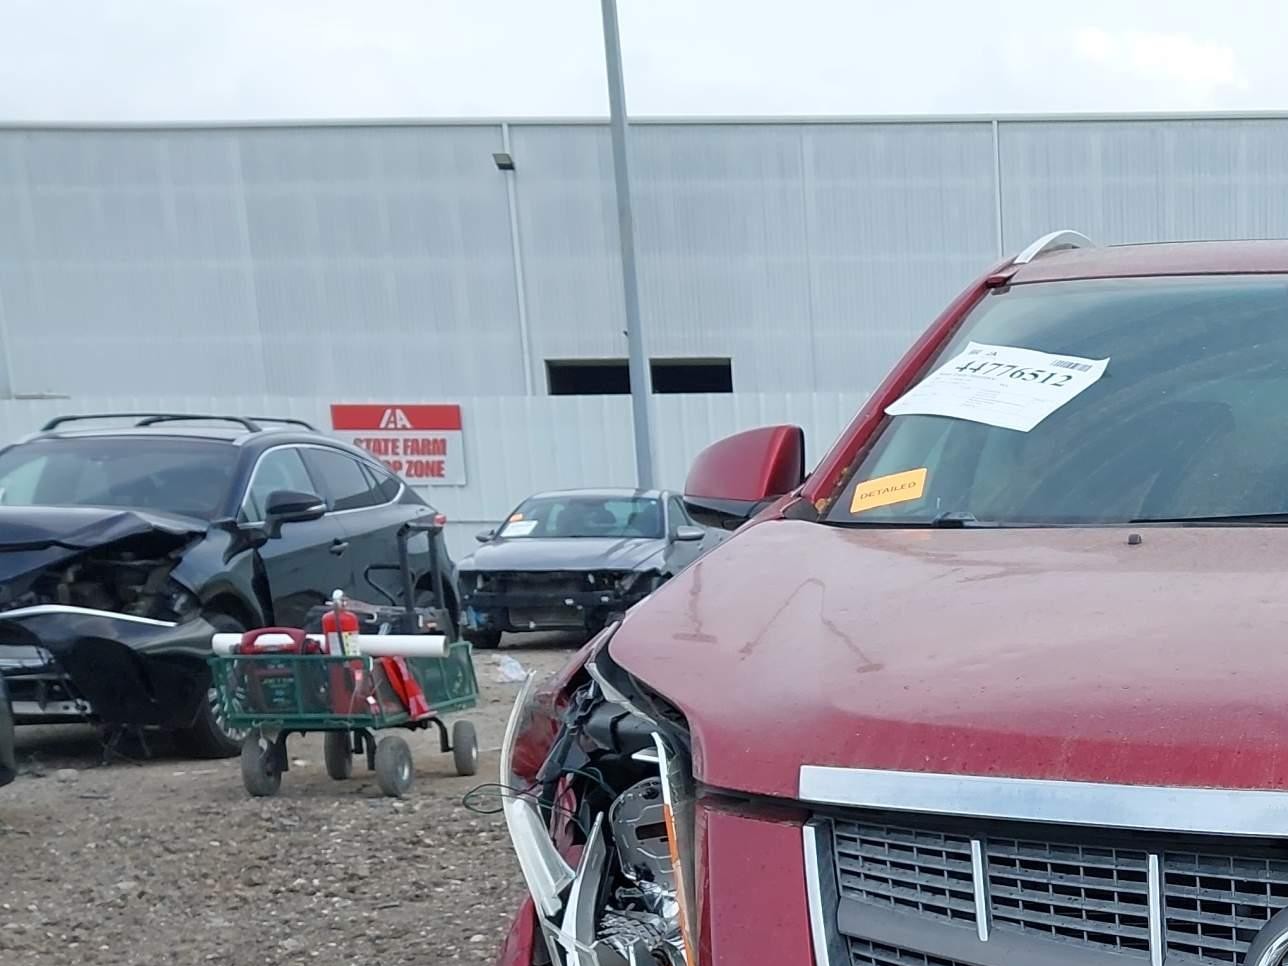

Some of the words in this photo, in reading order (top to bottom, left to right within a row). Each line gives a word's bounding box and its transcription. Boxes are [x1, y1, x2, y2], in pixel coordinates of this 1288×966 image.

[955, 360, 1074, 388] 44776512
[403, 438, 447, 456] FARM
[405, 460, 445, 478] ZONE
[860, 481, 917, 500] DETAILED
